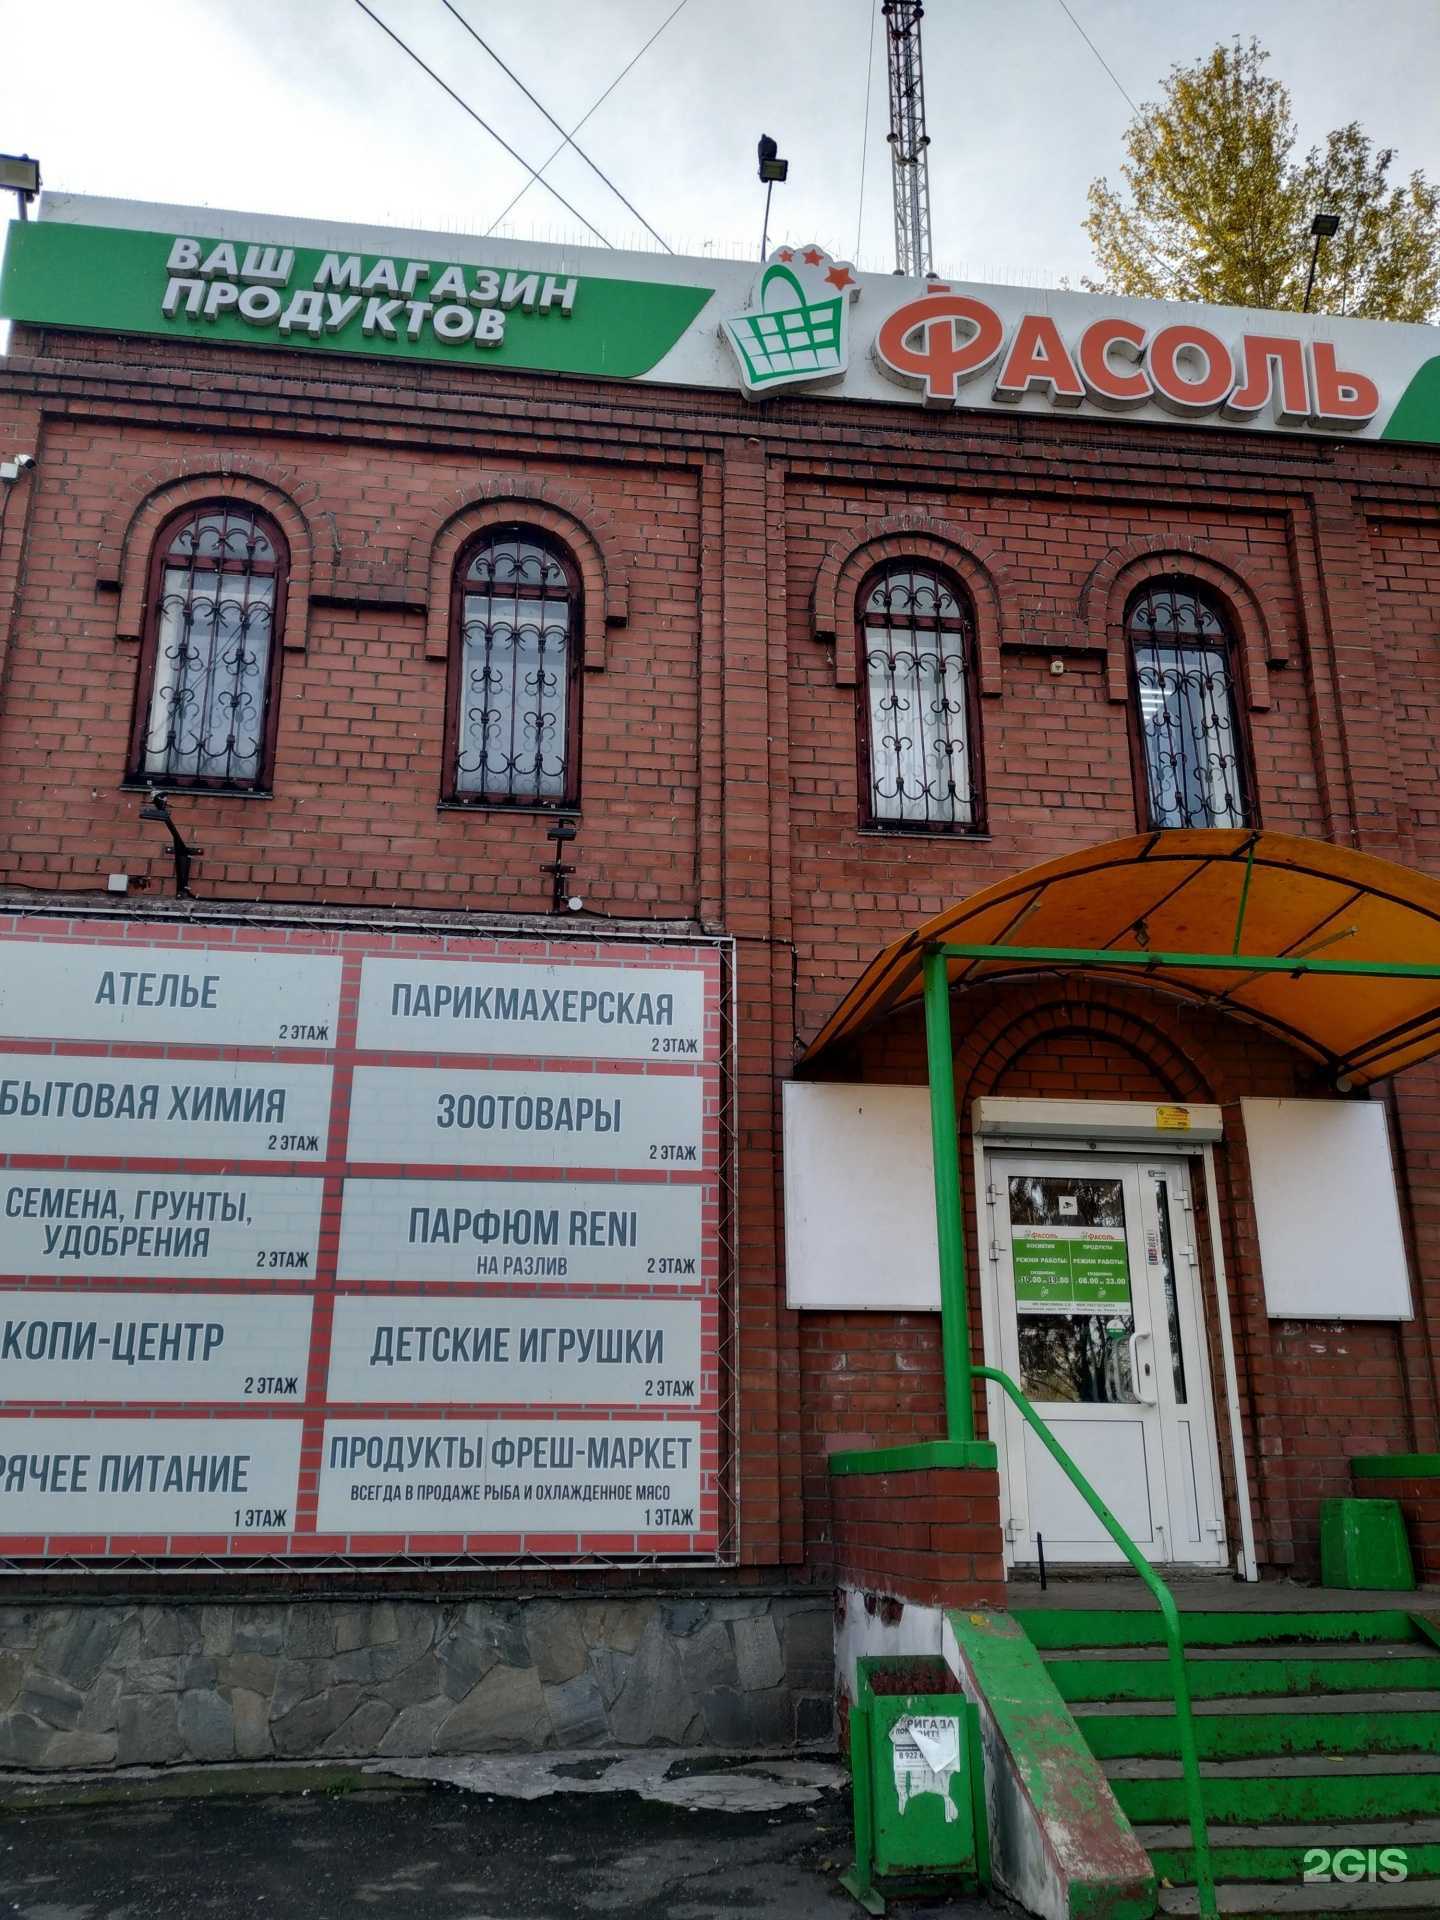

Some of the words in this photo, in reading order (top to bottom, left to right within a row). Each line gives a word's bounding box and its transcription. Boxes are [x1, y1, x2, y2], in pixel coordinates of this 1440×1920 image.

[166, 237, 295, 288] ВАШ
[313, 253, 578, 317] МАГАЗИН
[161, 276, 507, 348] ПРОДУКТОВ
[873, 285, 1381, 431] ФАСОЛЬ
[94, 971, 220, 1008] АТЕЛЬЕ
[391, 983, 673, 1026] ПАРИКМАХЕРСКАЯ
[279, 1024, 288, 1039] 2
[291, 1025, 329, 1041] ЭТАЖ
[652, 1038, 660, 1052] 2
[662, 1038, 698, 1053] ЭТАЖ
[0, 1079, 159, 1120] БЫТОВАЯ
[167, 1086, 286, 1124] ХИМИЯ
[437, 1093, 621, 1133] ЗООТОВАРЫ
[268, 1135, 278, 1150] 2
[280, 1136, 319, 1151] ЭТАЖ
[649, 1145, 658, 1160] 2
[661, 1145, 697, 1161] ЭТАЖ
[5, 1187, 124, 1223] СЕМЕНА,
[134, 1190, 252, 1225] ГРУНТЫ,
[43, 1225, 210, 1259] УДОБРЕНИЯ
[409, 1207, 560, 1246] ПАРФЮМ
[568, 1210, 637, 1247] RENI
[257, 1251, 266, 1267] 2
[269, 1252, 310, 1268] ЭТАЖ
[477, 1255, 498, 1275] НА
[503, 1256, 568, 1276] РАЗЛИВ
[647, 1258, 655, 1273] 2
[658, 1257, 696, 1274] ЭТАЖ
[1, 1321, 225, 1365] КОПИ-ЦЕНТР
[369, 1326, 510, 1366] ДЕТСКИЕ
[519, 1329, 664, 1364] ИГРУШКИ
[244, 1377, 254, 1394] 2
[257, 1377, 298, 1394] ЭТАЖ
[645, 1380, 653, 1396] 2
[656, 1380, 694, 1397] ЭТАЖ
[329, 1436, 483, 1473] ПРОДУКТЫ
[491, 1436, 692, 1469] ФРЕШ-МАРКЕТ
[99, 1455, 251, 1493] ПИТАНИЕ
[351, 1485, 401, 1502] ВСЕГДА
[405, 1485, 413, 1500] В
[416, 1485, 480, 1502] ПРОДАЖЕ
[484, 1485, 520, 1500] РЫБА
[523, 1485, 532, 1500] И
[536, 1485, 632, 1502] ОХЛАЖДЕННОЕ
[636, 1485, 670, 1500] МЯСО
[234, 1510, 241, 1526] 1
[245, 1510, 287, 1527] ЭТАЖ
[643, 1509, 650, 1525] 1
[654, 1508, 694, 1526] ЭТАЖ
